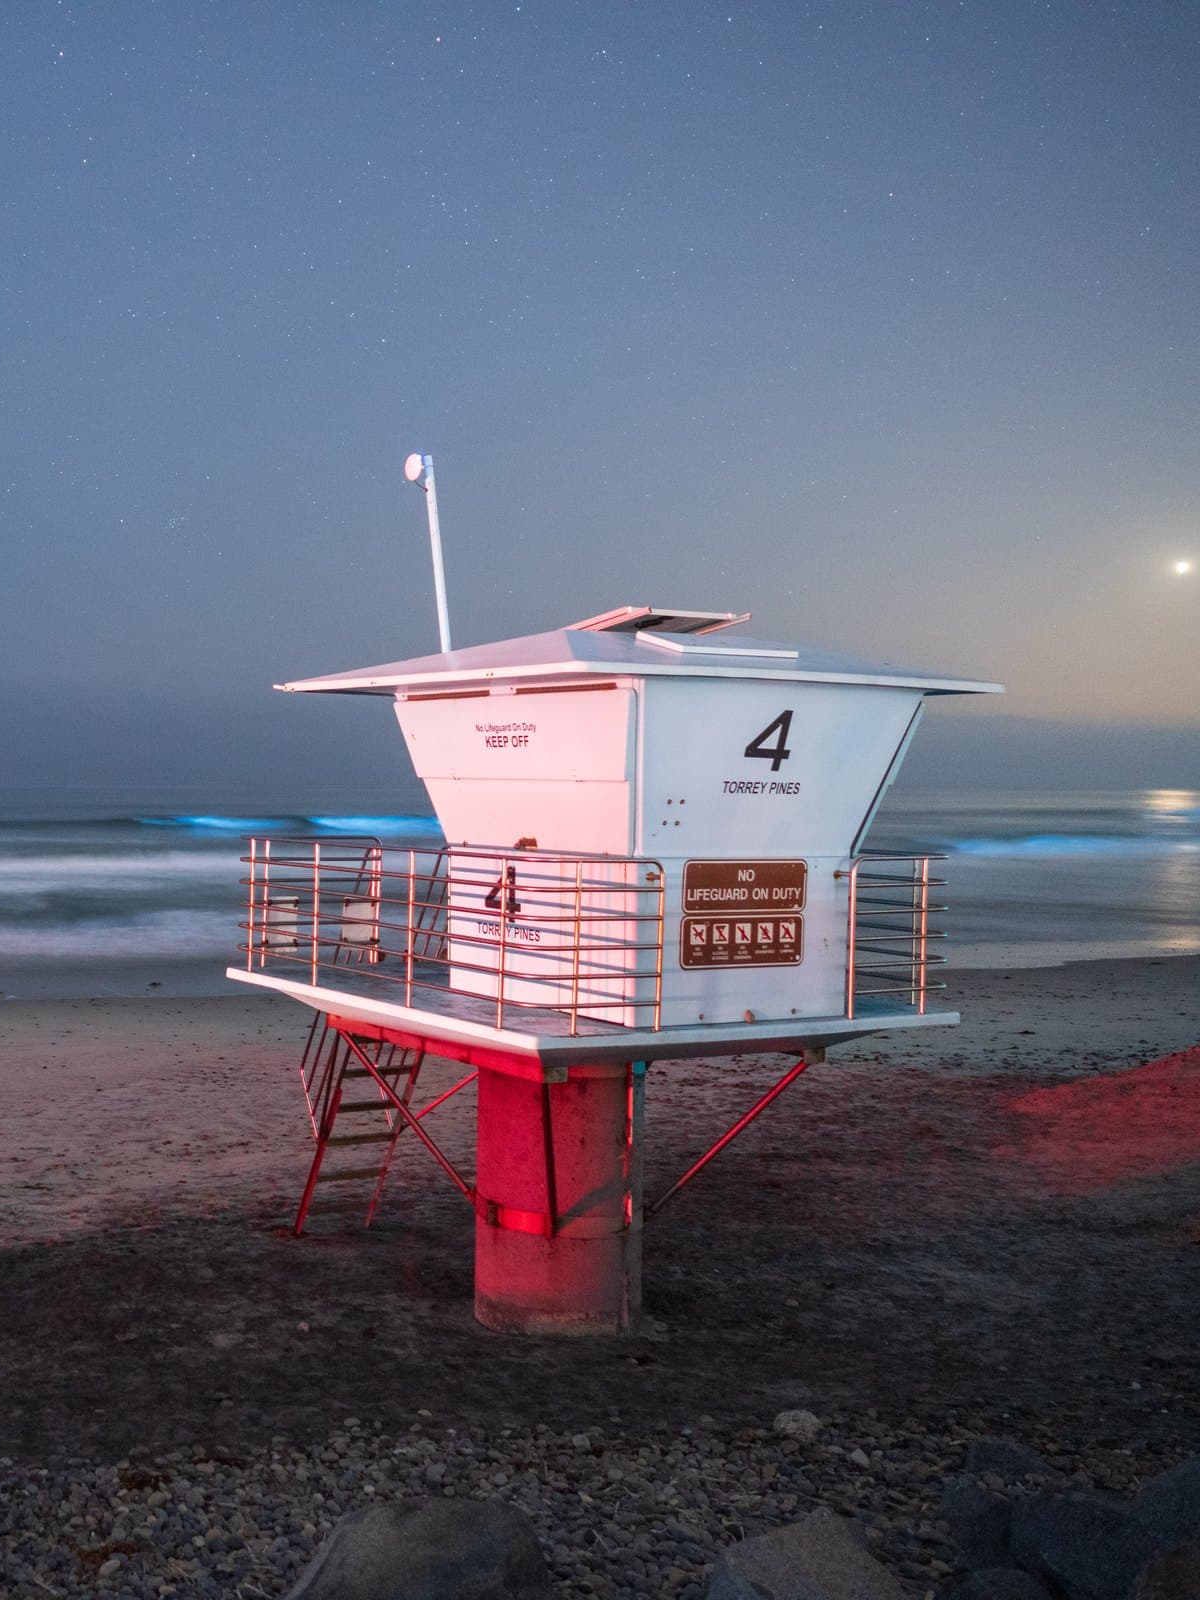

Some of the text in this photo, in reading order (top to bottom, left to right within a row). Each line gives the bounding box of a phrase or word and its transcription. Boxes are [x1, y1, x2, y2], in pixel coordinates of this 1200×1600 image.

[475, 724, 484, 733] No
[512, 722, 521, 732] On
[522, 722, 536, 733] Duty
[485, 735, 529, 748] KEEP OFF
[744, 709, 794, 772] 4
[722, 780, 801, 795] TORREY PINES
[737, 869, 755, 882] NO
[485, 866, 521, 923] 4
[687, 887, 801, 901] LIFEGUARD ON DUTY
[477, 921, 540, 942] TORRY PINES
